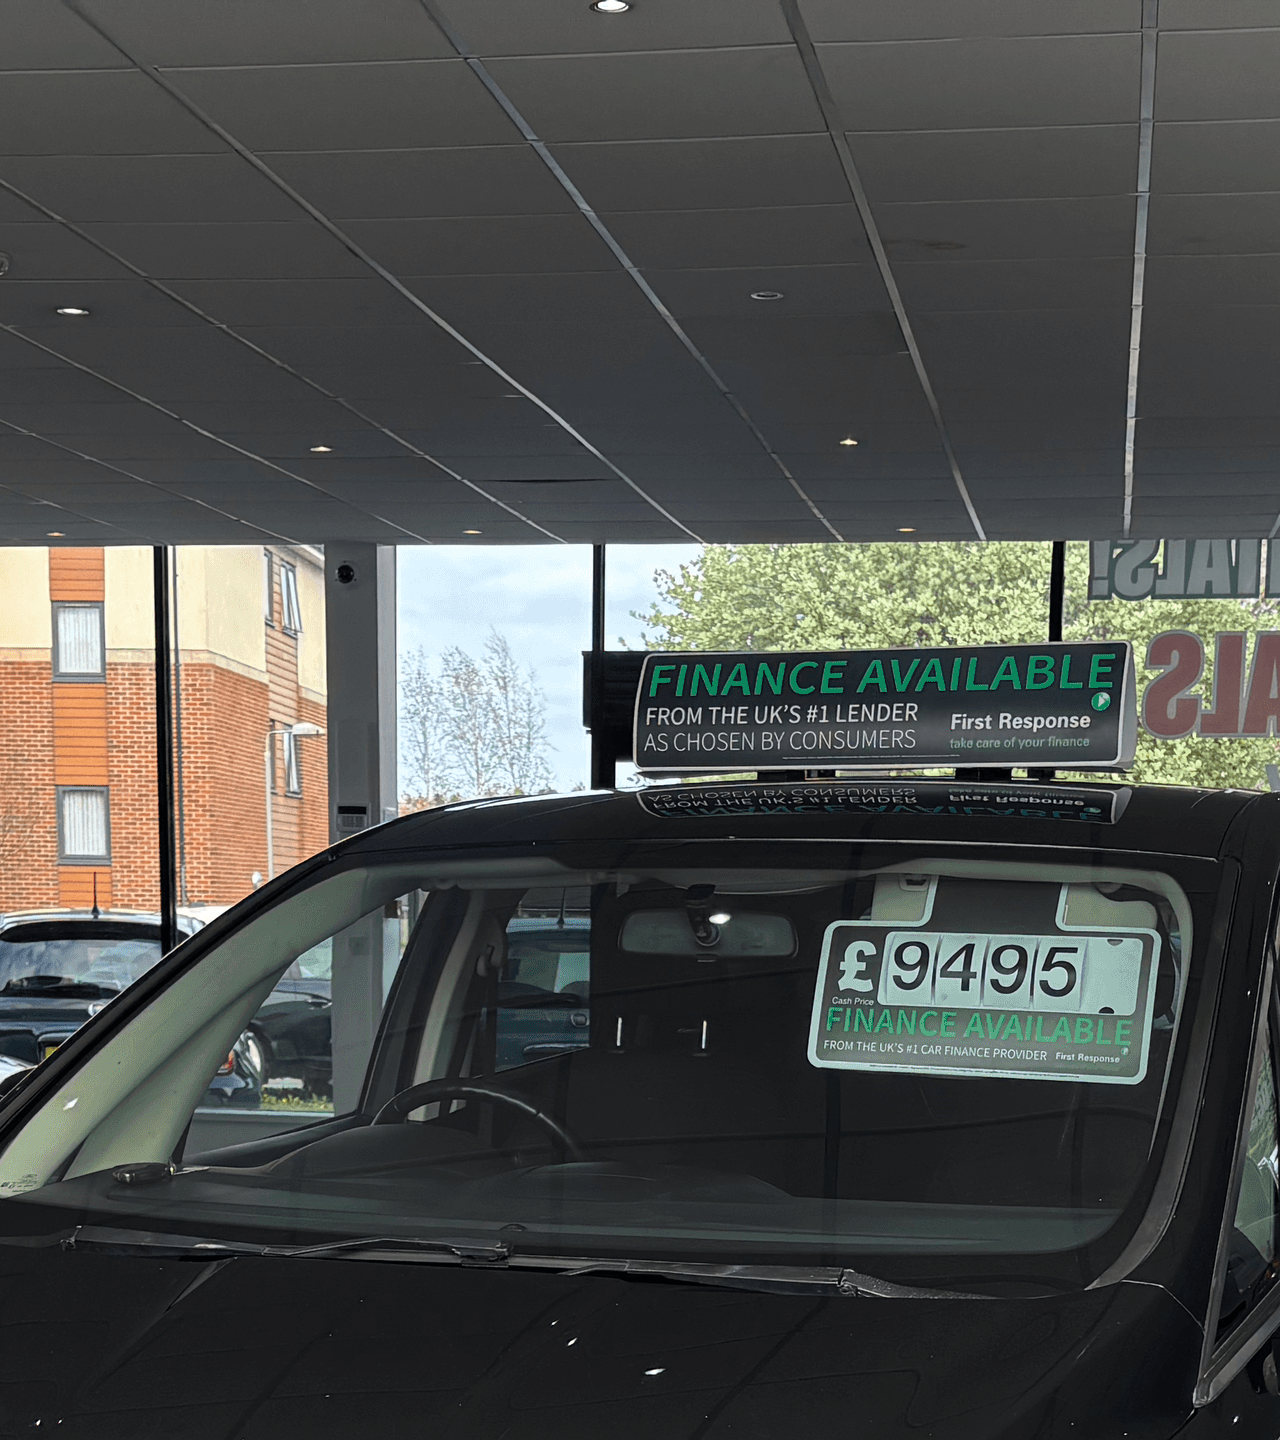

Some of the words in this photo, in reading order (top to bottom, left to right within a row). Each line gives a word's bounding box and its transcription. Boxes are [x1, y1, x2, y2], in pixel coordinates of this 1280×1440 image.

[649, 660, 848, 697] FINANCE
[856, 653, 1116, 693] AVAILABLE
[646, 706, 703, 726] FROM
[708, 705, 749, 725] THE
[806, 704, 829, 723] #1
[835, 702, 919, 723] LENDER
[950, 713, 992, 731] First
[998, 712, 1091, 733] Response
[643, 732, 669, 751] AS
[673, 731, 755, 751] CHOSEN
[761, 731, 785, 750] BY
[789, 729, 916, 750] CONSUMERS
[950, 736, 973, 749] take
[976, 738, 1001, 748] care
[1003, 736, 1017, 748] of
[1018, 738, 1045, 750] your
[1047, 735, 1090, 748] finance
[837, 940, 1079, 997] £9495
[831, 996, 852, 1006] Cash
[854, 997, 875, 1006] Price
[825, 1006, 957, 1038] FINANCE
[963, 1014, 1133, 1047] AVAILABLE
[823, 1039, 853, 1052] FROM
[856, 1041, 876, 1053] THE
[906, 1044, 918, 1055] #1
[921, 1044, 942, 1056] CAR
[944, 1045, 990, 1058] FINANCE
[993, 1048, 1047, 1061] PROVIDER
[1055, 1052, 1076, 1062] First
[1077, 1053, 1120, 1065] Response
